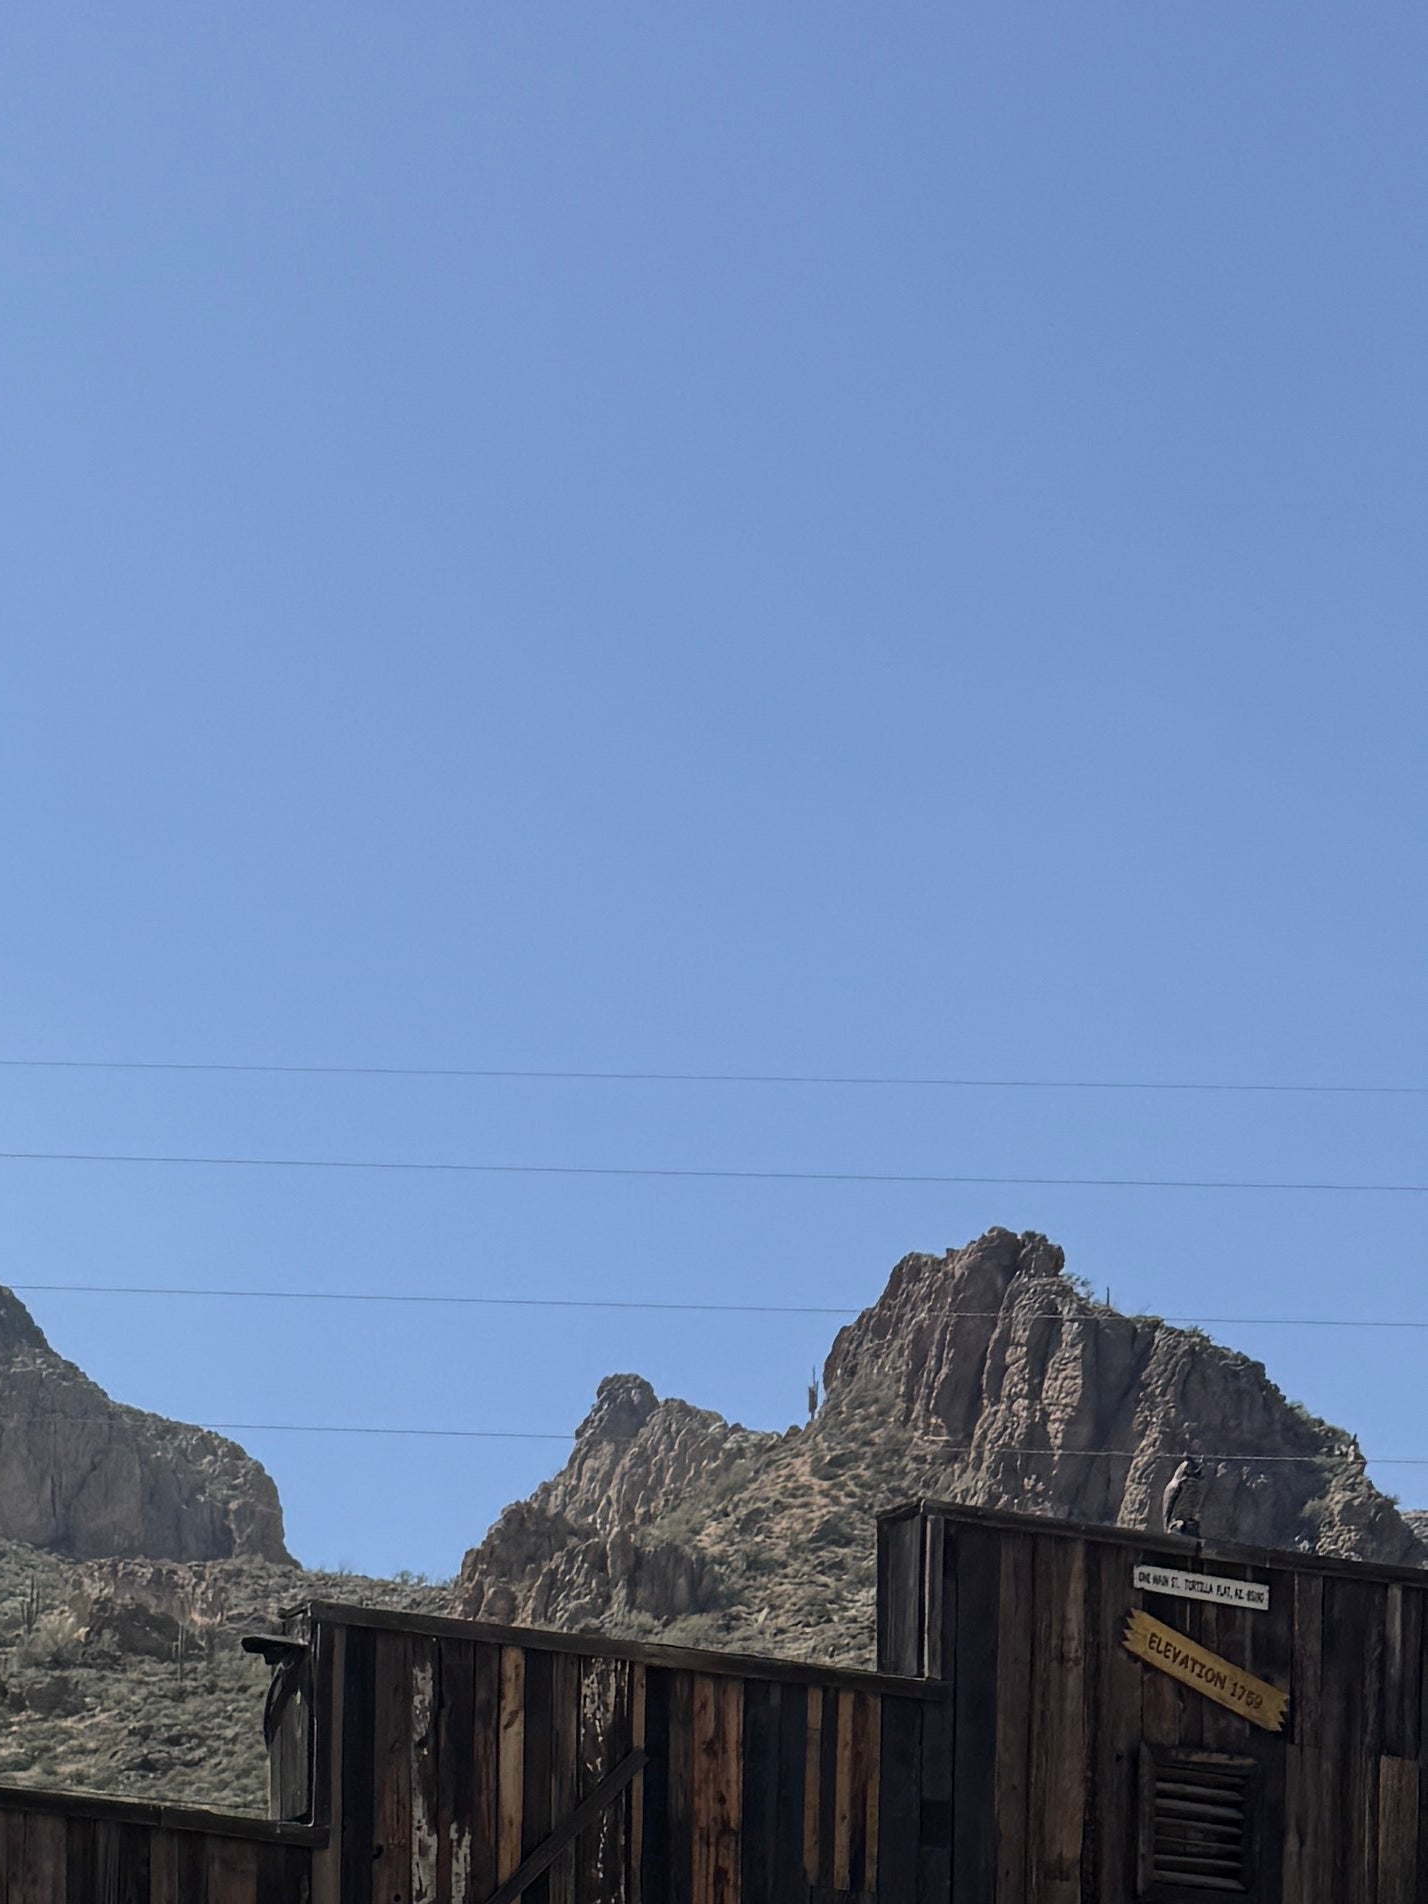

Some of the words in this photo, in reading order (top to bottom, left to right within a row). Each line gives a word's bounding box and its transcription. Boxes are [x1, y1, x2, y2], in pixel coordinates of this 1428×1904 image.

[1153, 1575, 1169, 1587] MAIN
[1184, 1579, 1213, 1595] TORTILLA
[1148, 1632, 1228, 1691] ELEVATION
